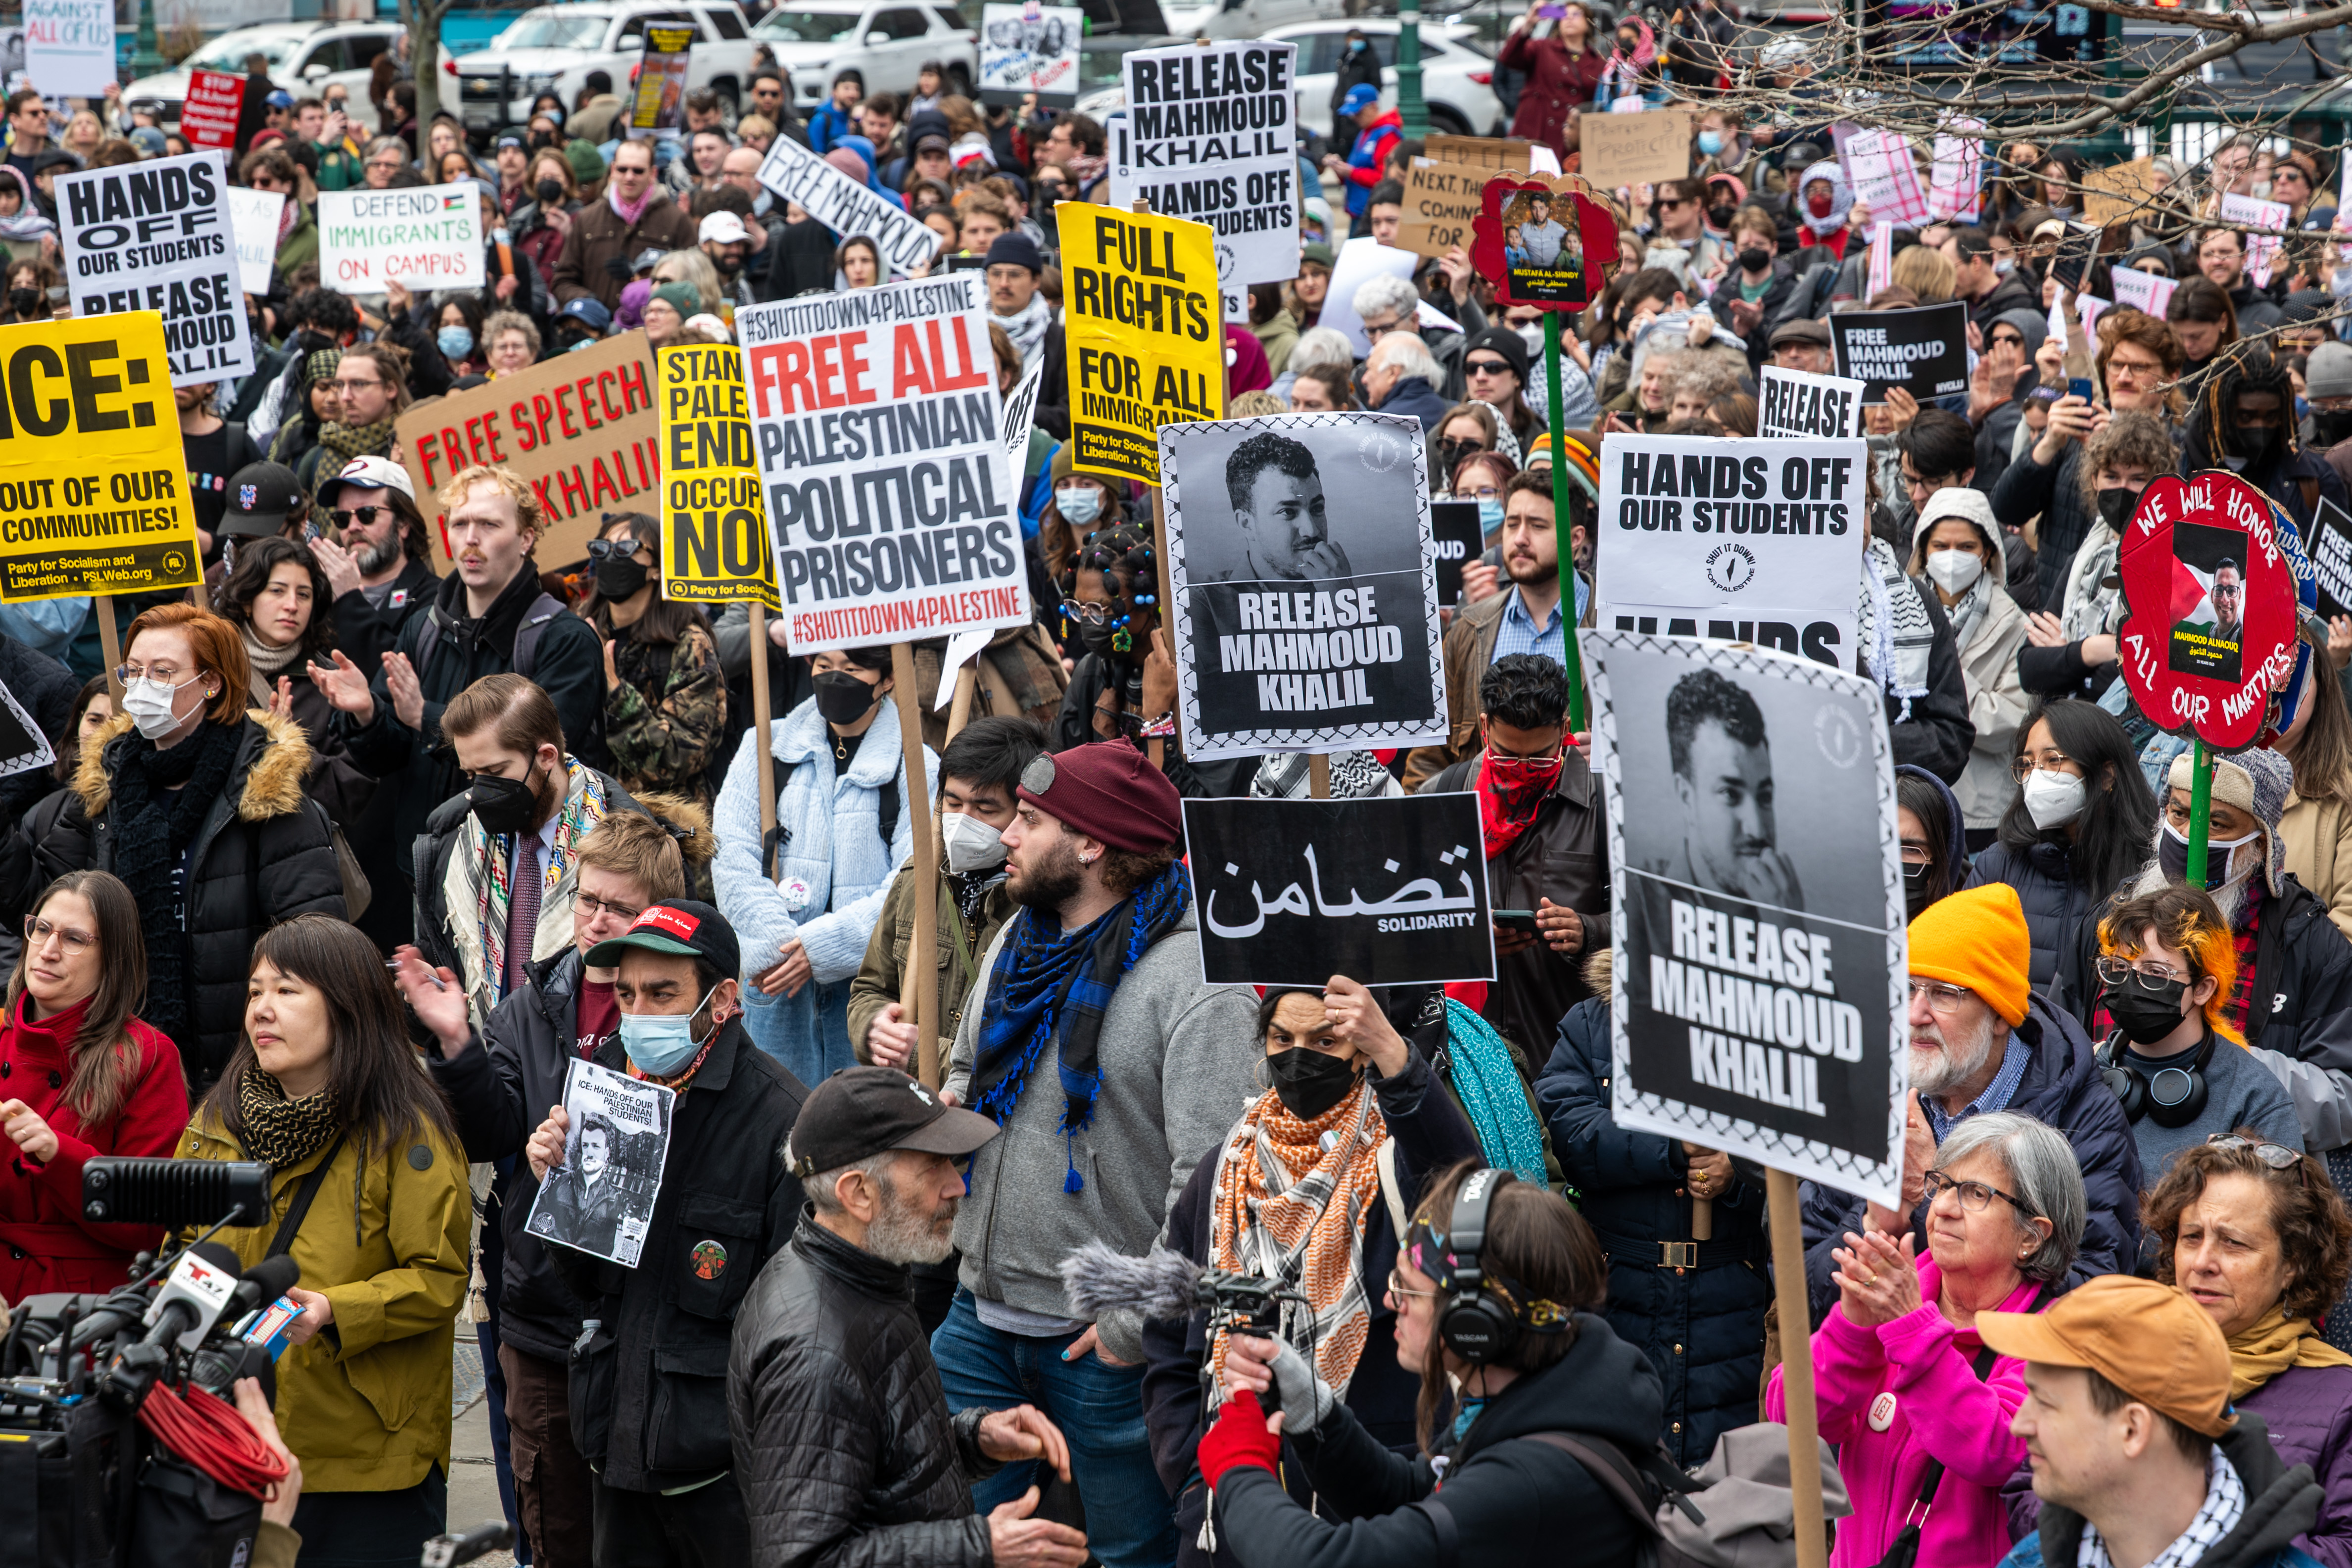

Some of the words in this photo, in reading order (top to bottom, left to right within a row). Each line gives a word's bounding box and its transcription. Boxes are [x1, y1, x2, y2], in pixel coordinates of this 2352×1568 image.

[27, 0, 105, 18] AGAINST
[25, 21, 58, 43] ALL
[62, 21, 84, 45] OF
[88, 21, 110, 47] US
[202, 74, 235, 91] STOP
[1131, 49, 1289, 103] RELEASE
[1134, 94, 1286, 140] MAHMOUD
[1136, 131, 1288, 167] KHALIL
[67, 161, 216, 227] HANDS
[1140, 176, 1237, 215] HANDS
[1247, 169, 1290, 205] OFF
[1412, 170, 1456, 194] NEXT,
[353, 193, 437, 217] DEFEND
[762, 141, 832, 209] FREE
[817, 178, 932, 269] MAHMOUD
[78, 207, 217, 249] OFF
[329, 218, 472, 248] IMMIGRANTS
[1428, 224, 1462, 246] FOR
[78, 252, 120, 277] OUR
[125, 234, 225, 269] STUDENTS
[236, 244, 268, 264] ALIL
[338, 258, 369, 281] ON
[385, 251, 466, 275] CAMPUS
[1095, 215, 1186, 284] FULL
[1514, 268, 1544, 277] MUSTAFA
[1544, 270, 1579, 279] AL-SHINDY
[746, 279, 975, 342] #SHUTITDOWN4PALESTINE
[1073, 266, 1209, 342] RIGHTS
[162, 314, 236, 352] MOUD
[1845, 328, 1887, 346] FREE
[1847, 340, 1946, 362] MAHMOUD
[168, 346, 241, 375] ALIL
[668, 350, 745, 382] STAN
[750, 330, 876, 419] FREE
[892, 315, 989, 399] ALL
[1850, 362, 1913, 380] KHALIL
[1079, 347, 1143, 402] FOR
[1152, 366, 1214, 418] ALL
[1935, 379, 1964, 394] NYCLU
[416, 411, 508, 490] FREE
[510, 360, 652, 451] SPEECH
[1082, 391, 1206, 432] IMMIGRA
[1765, 377, 1852, 438] RELEASE
[671, 421, 754, 471] END
[759, 391, 995, 472] PALESTINIAN
[1082, 430, 1108, 446] Party
[1109, 435, 1122, 448] for
[1358, 435, 1371, 453] SHUT
[1380, 432, 1400, 449] DOWN!
[1083, 445, 1129, 464] Liberation
[1359, 455, 1370, 469] FOR
[1370, 451, 1400, 473] PALESTINE
[0, 479, 53, 512] OUT
[63, 475, 100, 507] OF
[110, 470, 176, 503] OUR
[1622, 452, 1768, 500] HANDS
[1781, 457, 1852, 501] OFF
[770, 454, 1008, 547] POLITICAL
[1619, 499, 1682, 532] OUR
[1692, 501, 1848, 535] STUDENTS
[2, 506, 180, 543] COMMUNITIES!
[2137, 493, 2167, 536] WE
[2180, 483, 2215, 515] WILL
[2227, 488, 2277, 569] HONOR
[8, 561, 39, 574] Party
[40, 560, 56, 572] for
[59, 557, 111, 570] Socialism
[113, 554, 135, 567] and
[168, 558, 181, 568] PSL
[780, 522, 1016, 605] PRISONERS
[1706, 546, 1723, 565] SHUT
[1724, 543, 1731, 552] IT
[1733, 544, 1756, 565] DOWN!
[2315, 541, 2352, 588] MAHM
[10, 573, 68, 589] Liberation
[83, 569, 152, 583] PSLWeb.org
[690, 585, 717, 596] Party
[719, 585, 734, 594] for
[1707, 568, 1717, 586] FOR
[1716, 568, 1755, 592] PALESTINE
[793, 585, 1021, 644] #SHUTITDOWN4PALESTINE
[1238, 586, 1377, 630] RELEASE
[1219, 625, 1403, 672] MAHMOUD
[2174, 631, 2207, 645] MAHMOOD
[2208, 638, 2238, 653] ALNAOUQ
[1257, 668, 1373, 711] KHALIL
[2125, 634, 2158, 692] ALL
[2172, 686, 2210, 724] OUR
[2222, 642, 2291, 726] MARTYRS
[1206, 843, 1476, 938] تضامن
[1378, 912, 1476, 933] SOLIDARITY
[1671, 899, 1833, 995] RELEASE
[1650, 954, 1863, 1063] MAHMOUD
[1688, 1025, 1826, 1117] KHALIL
[578, 1080, 592, 1091] ICE:
[594, 1085, 618, 1099] HANDS
[620, 1094, 634, 1104] OFF
[635, 1099, 653, 1110] OUR
[604, 1097, 652, 1118] PALESTINIAN
[609, 1107, 651, 1126] STUDENTS!
[1454, 1333, 1489, 1343] TASCAM
